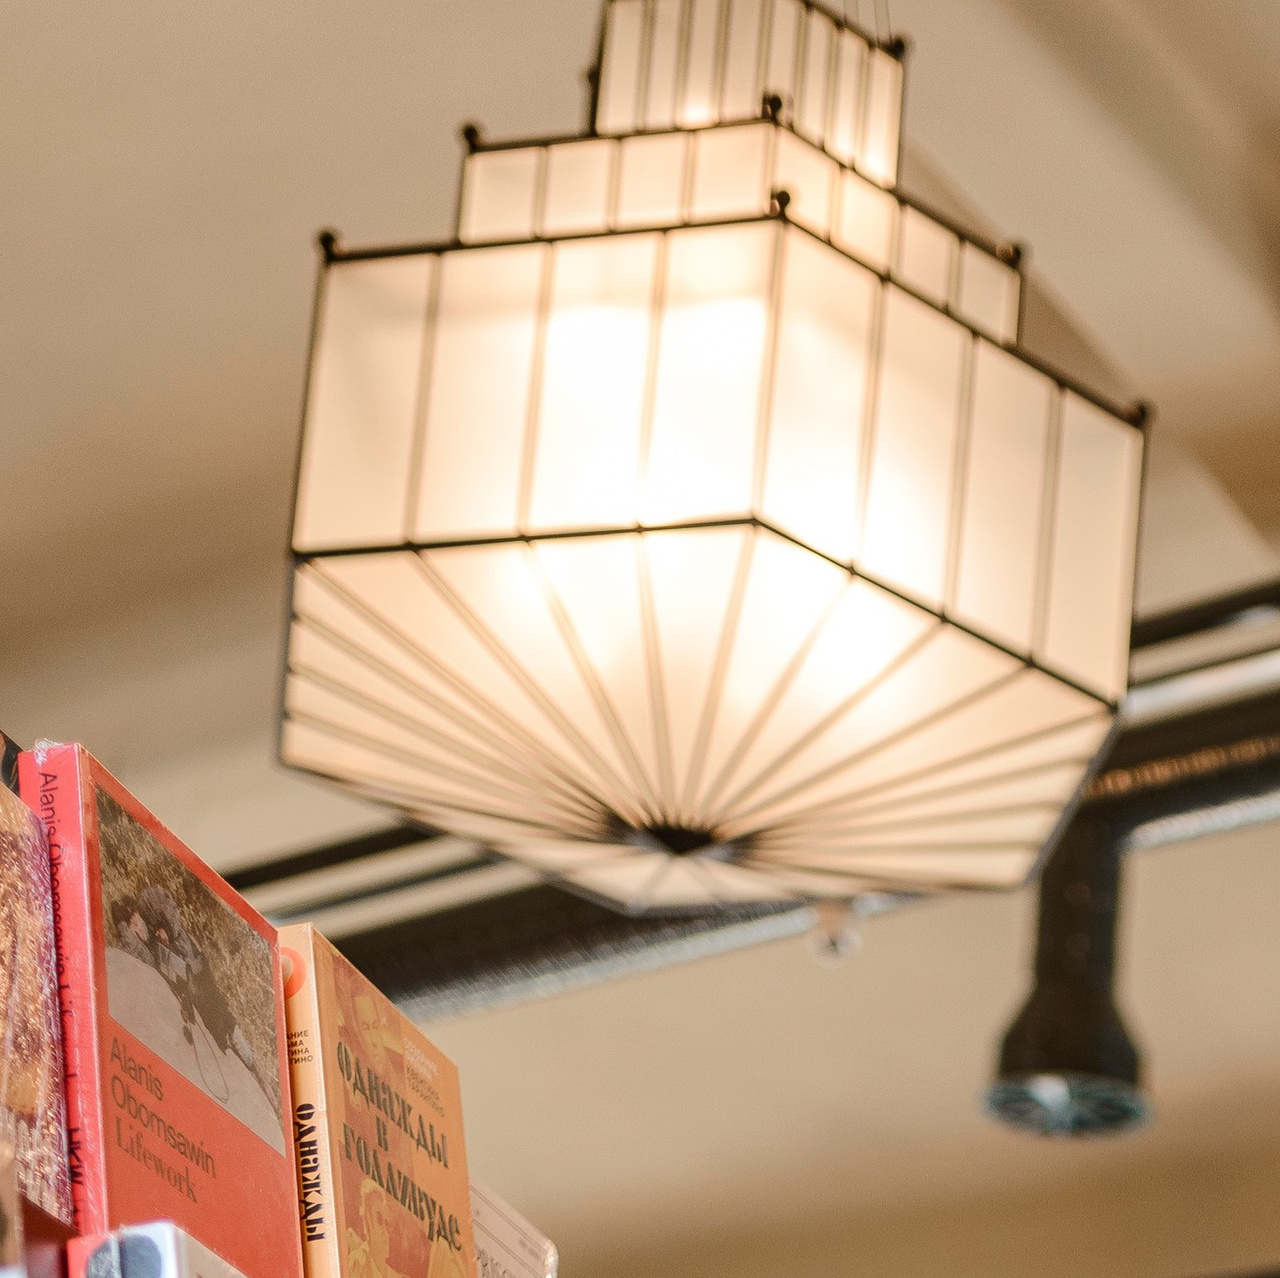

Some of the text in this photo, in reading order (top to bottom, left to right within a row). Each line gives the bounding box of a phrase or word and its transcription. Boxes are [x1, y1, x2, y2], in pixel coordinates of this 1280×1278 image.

[110, 1037, 163, 1101] Alanis
[111, 1075, 216, 1179] Obomsawin
[116, 1117, 198, 1204] Lifework
[343, 1122, 462, 1251] ГОЛЛИВУДЕ
